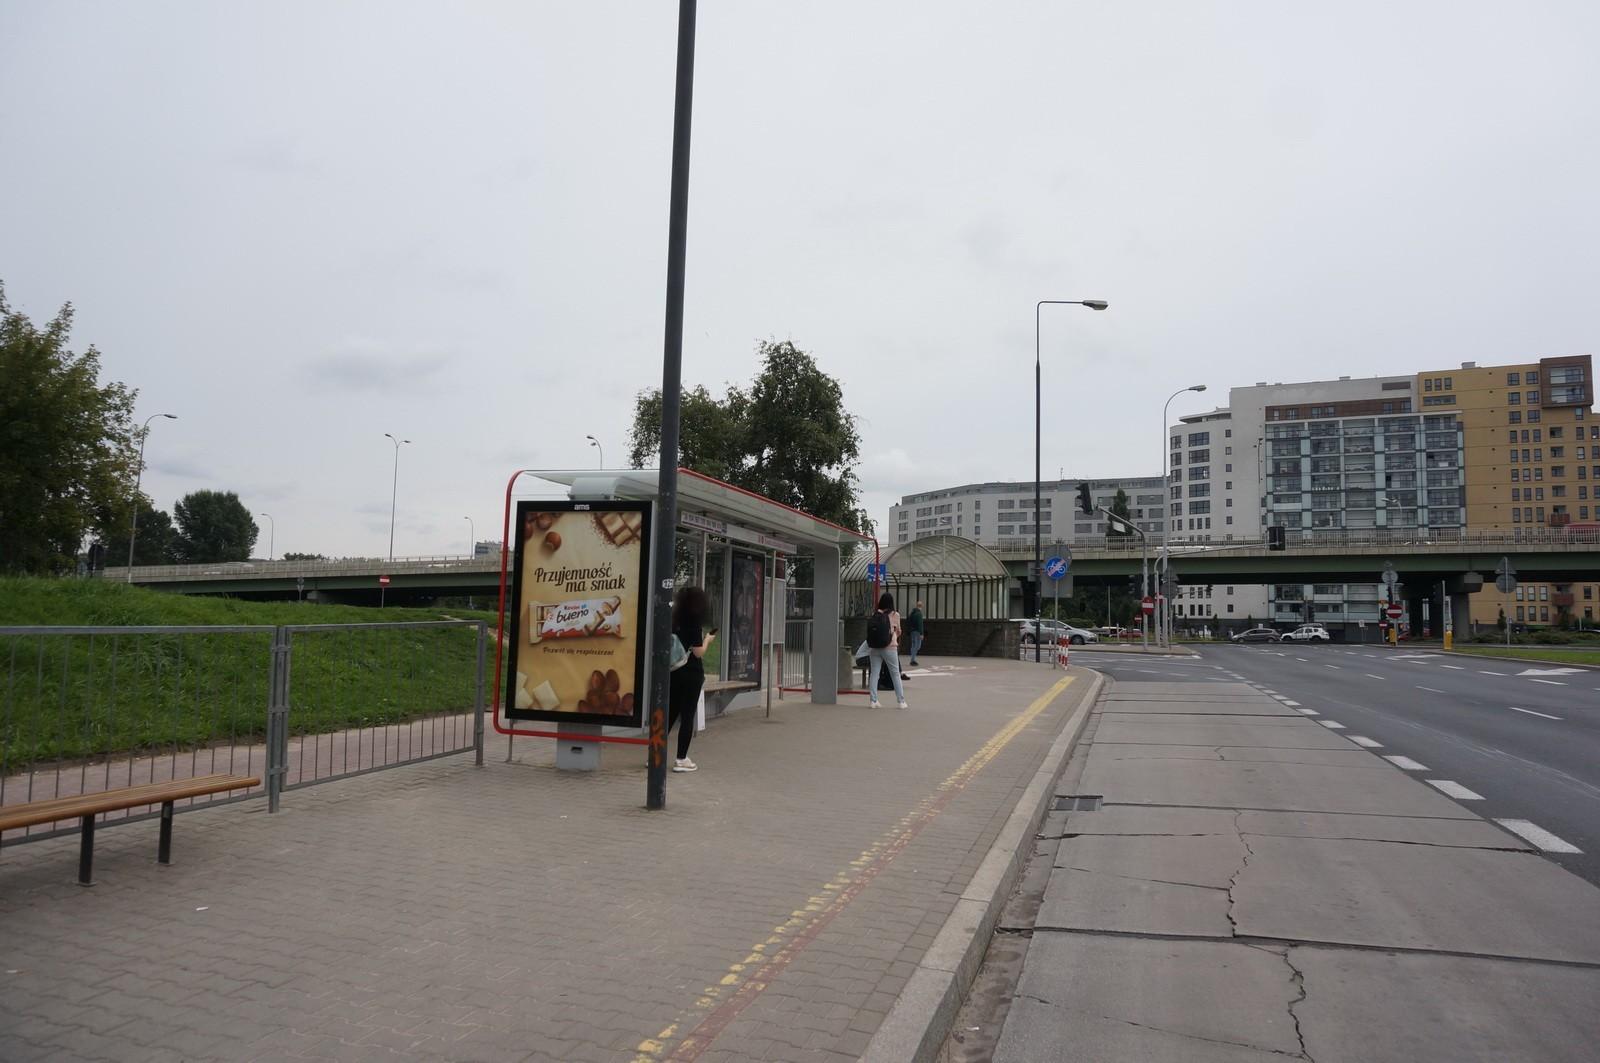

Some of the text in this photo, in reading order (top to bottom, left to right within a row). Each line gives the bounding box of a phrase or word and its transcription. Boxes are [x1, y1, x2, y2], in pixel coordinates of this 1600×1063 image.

[534, 562, 612, 587] Przyjemność
[565, 574, 626, 593] ma smak
[556, 608, 589, 624] bueno
